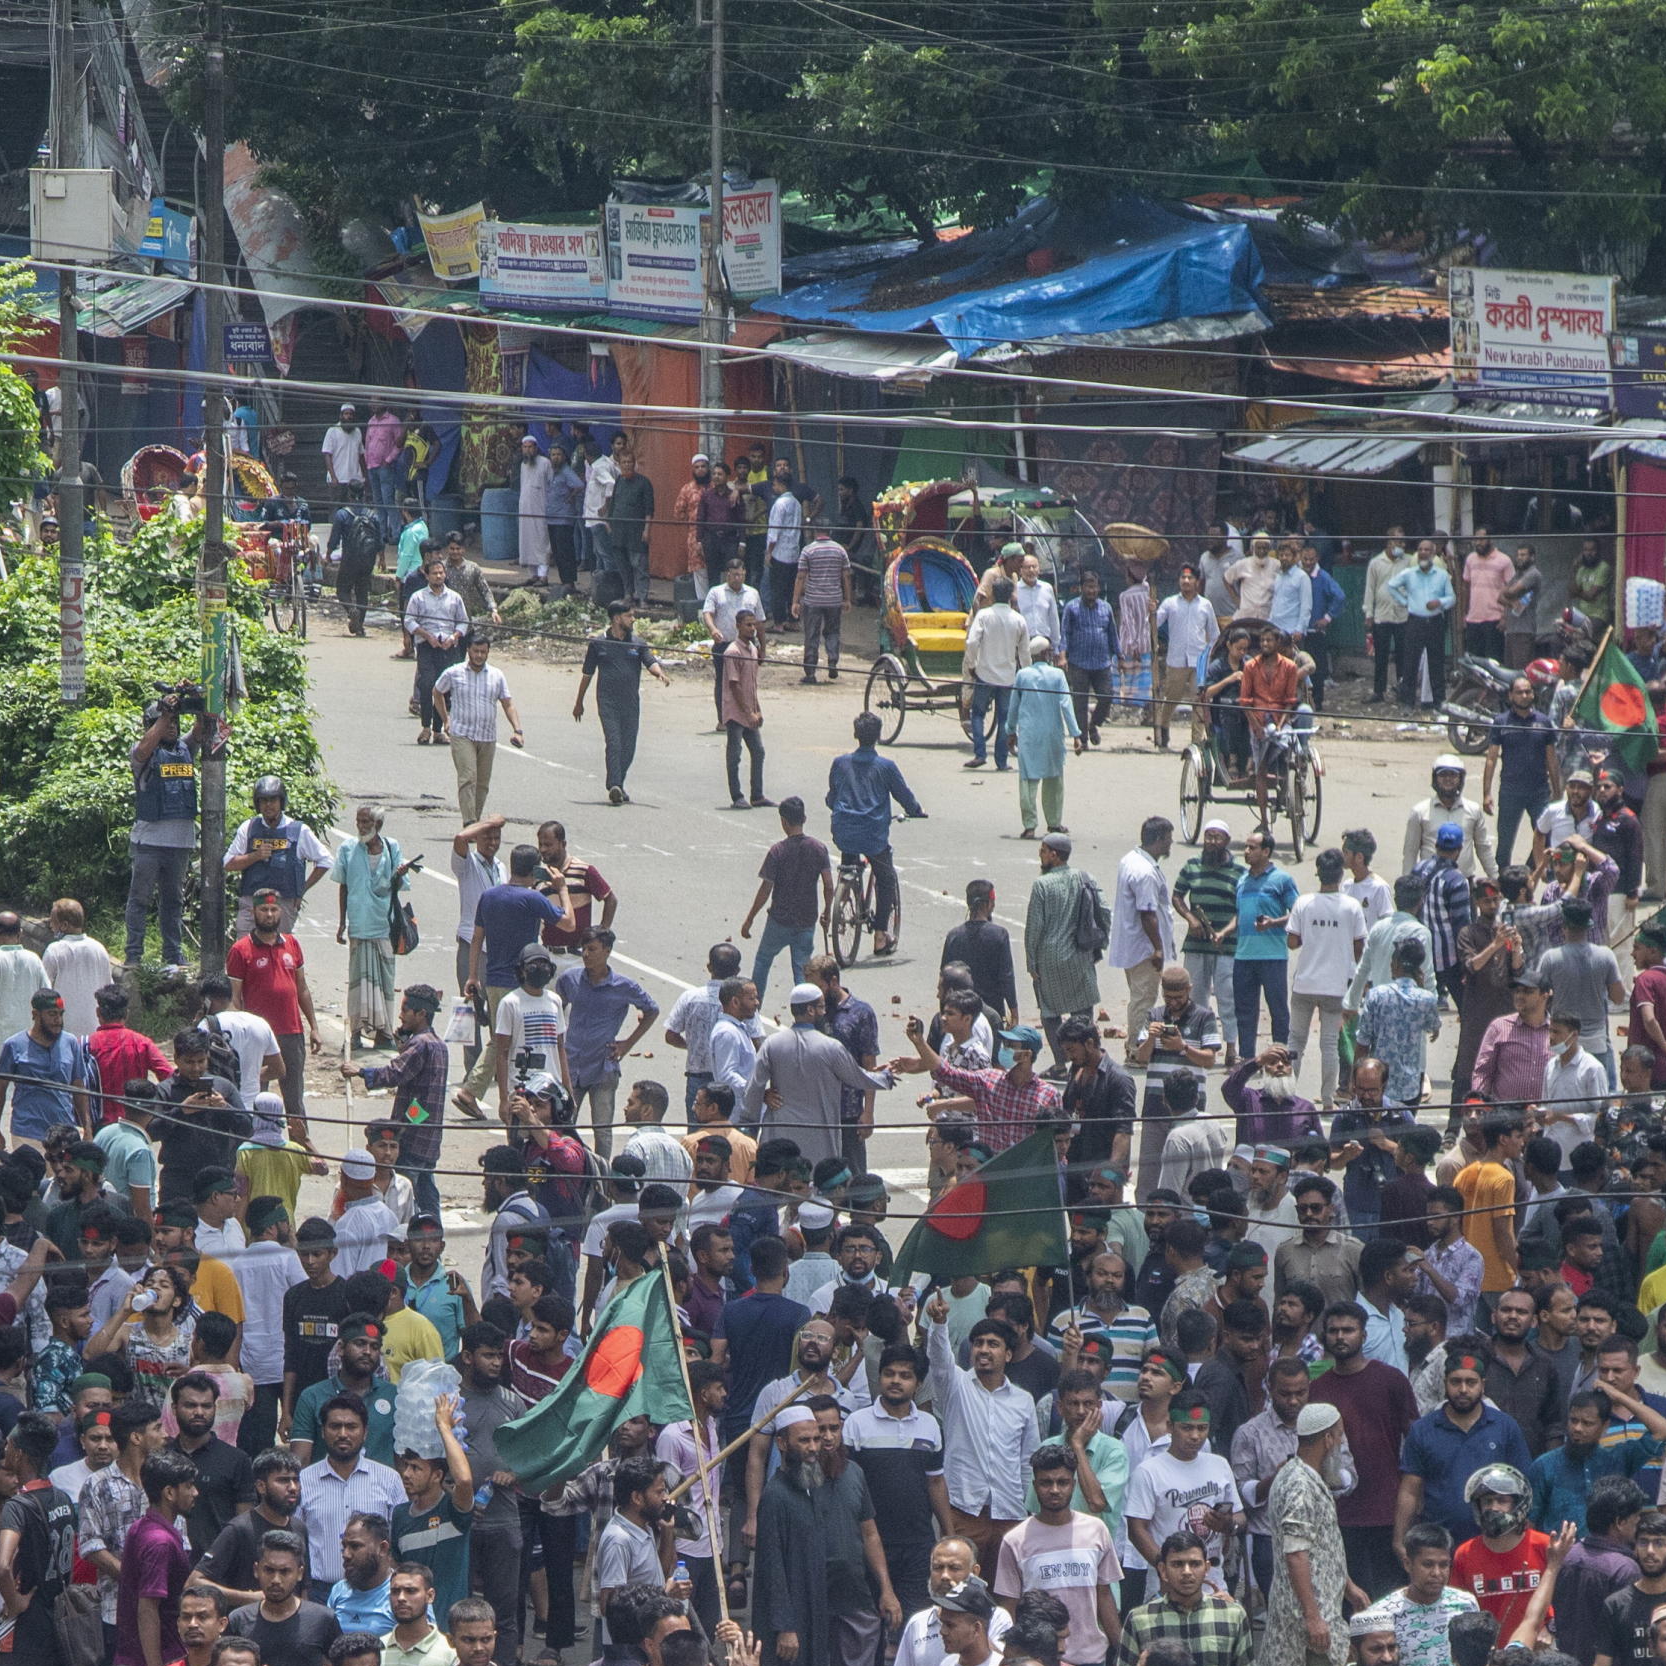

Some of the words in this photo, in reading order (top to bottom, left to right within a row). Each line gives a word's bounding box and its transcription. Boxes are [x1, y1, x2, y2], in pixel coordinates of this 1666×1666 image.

[497, 227, 526, 254] সাদিয়া
[529, 234, 566, 257] ফ্লাওয়ার
[567, 235, 584, 256] সপ
[1485, 284, 1501, 300] নিউ
[1485, 294, 1532, 332] করবী
[230, 341, 265, 352] ধন্যবাদ
[1485, 347, 1511, 363] New
[1511, 350, 1543, 366] karabi
[162, 765, 192, 776] PRESS
[254, 839, 289, 849] PSS
[1312, 919, 1339, 928] ABIR
[1040, 1563, 1091, 1580] ENJOY
